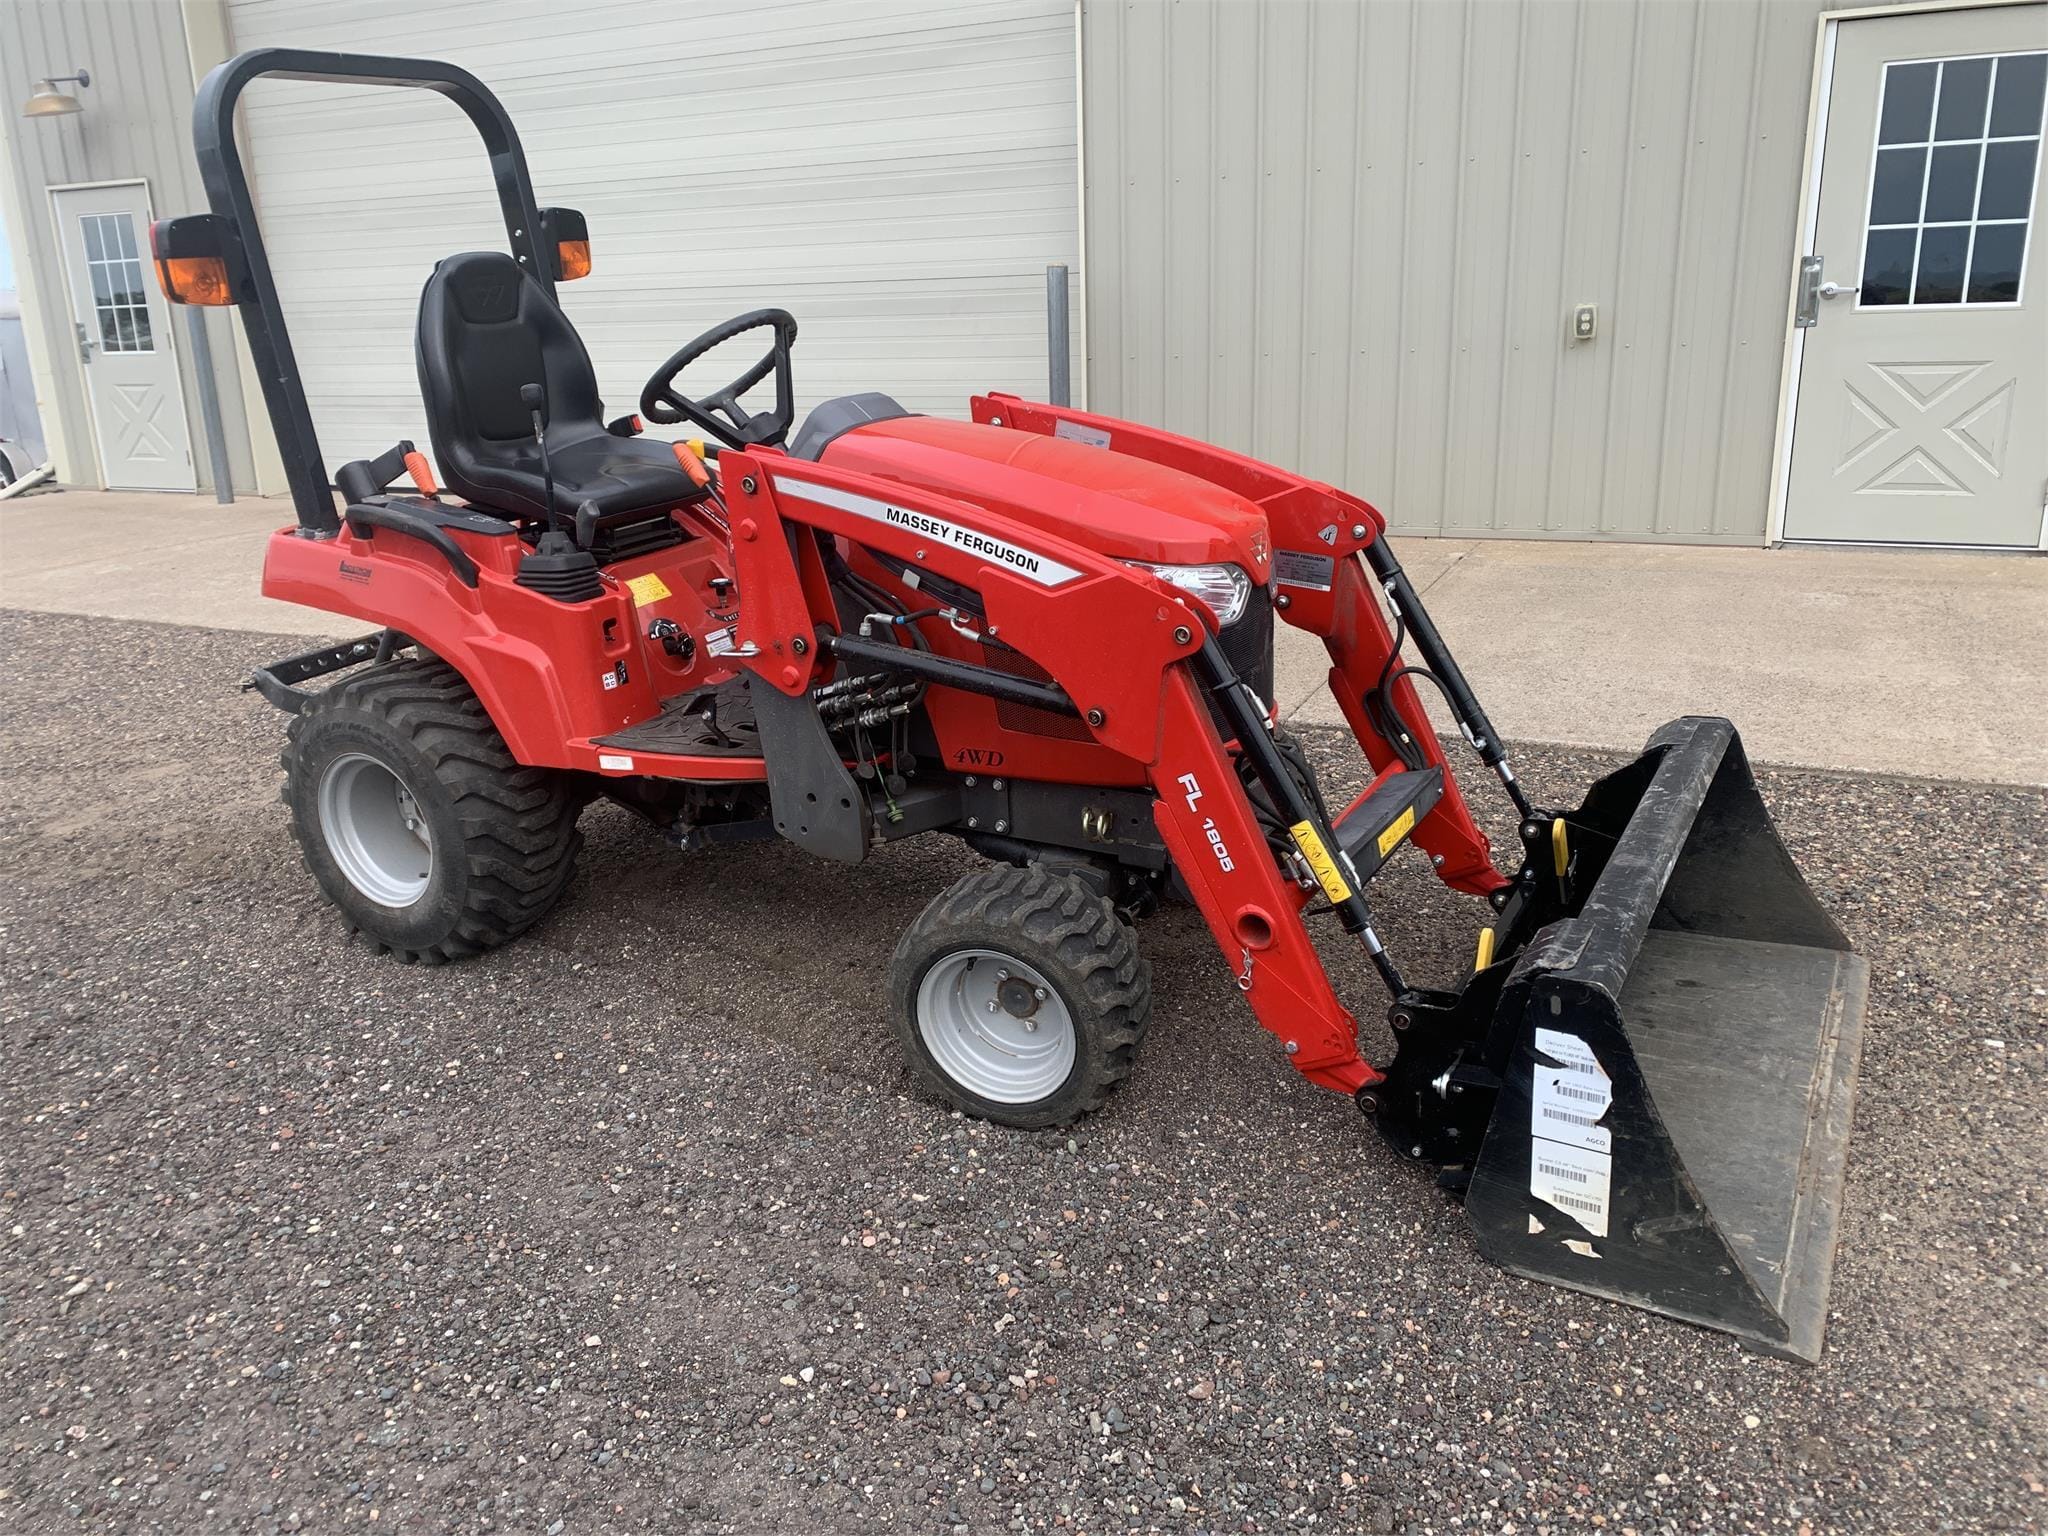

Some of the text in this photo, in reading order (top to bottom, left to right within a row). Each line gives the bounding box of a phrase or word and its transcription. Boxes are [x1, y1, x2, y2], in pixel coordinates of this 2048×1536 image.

[886, 507, 1039, 574] MASSEY FERGUSON
[953, 747, 1004, 767] 4WD
[1177, 772, 1236, 873] FL 1805
[1585, 1136, 1606, 1147] AGCO
